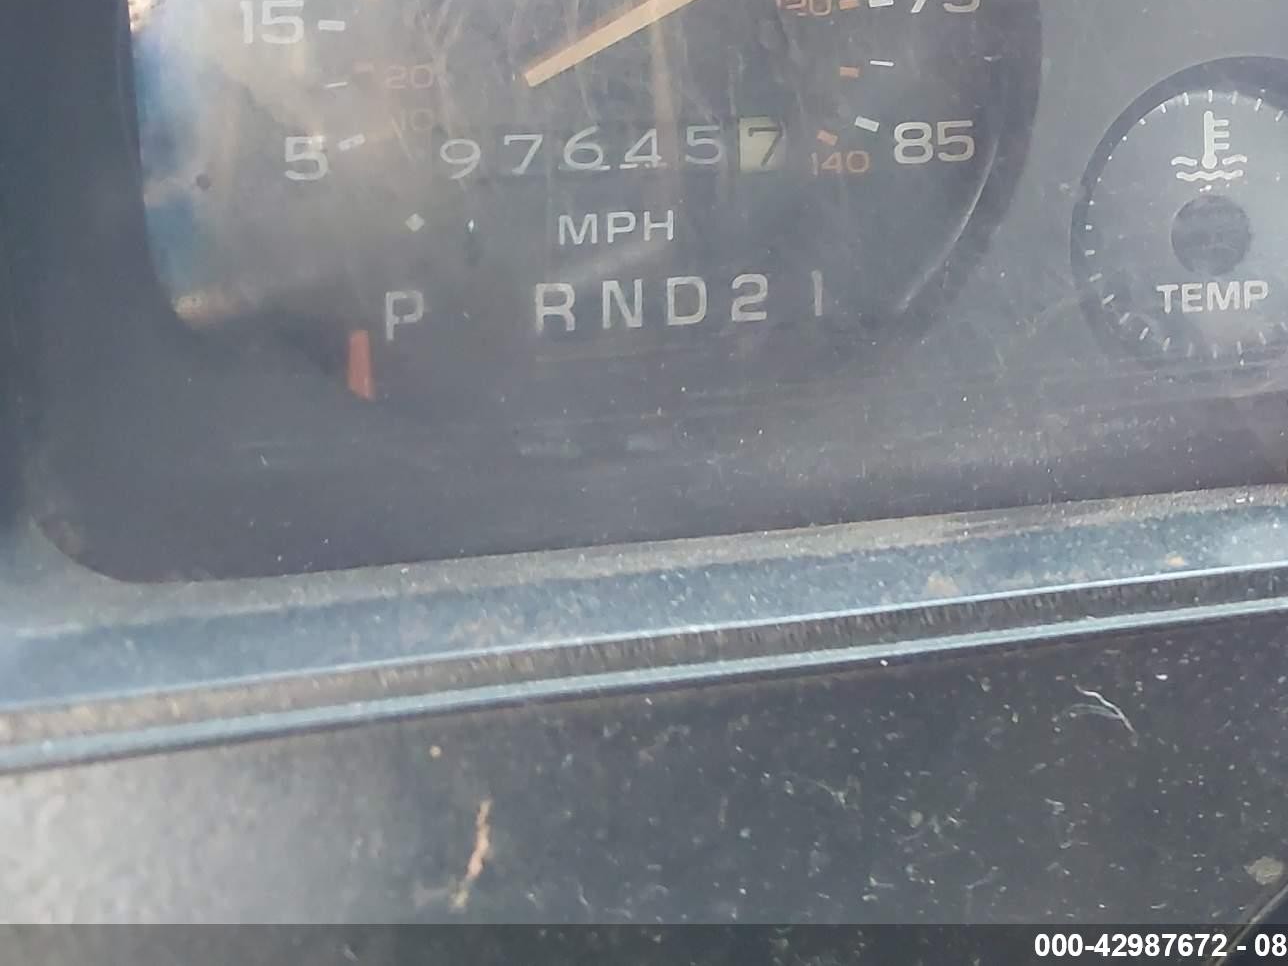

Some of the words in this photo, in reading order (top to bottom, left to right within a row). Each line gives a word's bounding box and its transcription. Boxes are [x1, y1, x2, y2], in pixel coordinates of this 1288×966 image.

[240, 0, 305, 45] 15
[384, 65, 433, 90] 20
[284, 136, 329, 180] 5
[893, 120, 975, 164] 85
[810, 150, 870, 176] 140
[558, 209, 675, 245] MPH
[384, 290, 424, 341] P
[535, 282, 576, 333] R
[602, 278, 644, 329] N
[666, 276, 708, 327] D
[731, 273, 769, 322] 2
[1156, 281, 1269, 313] TEMP
